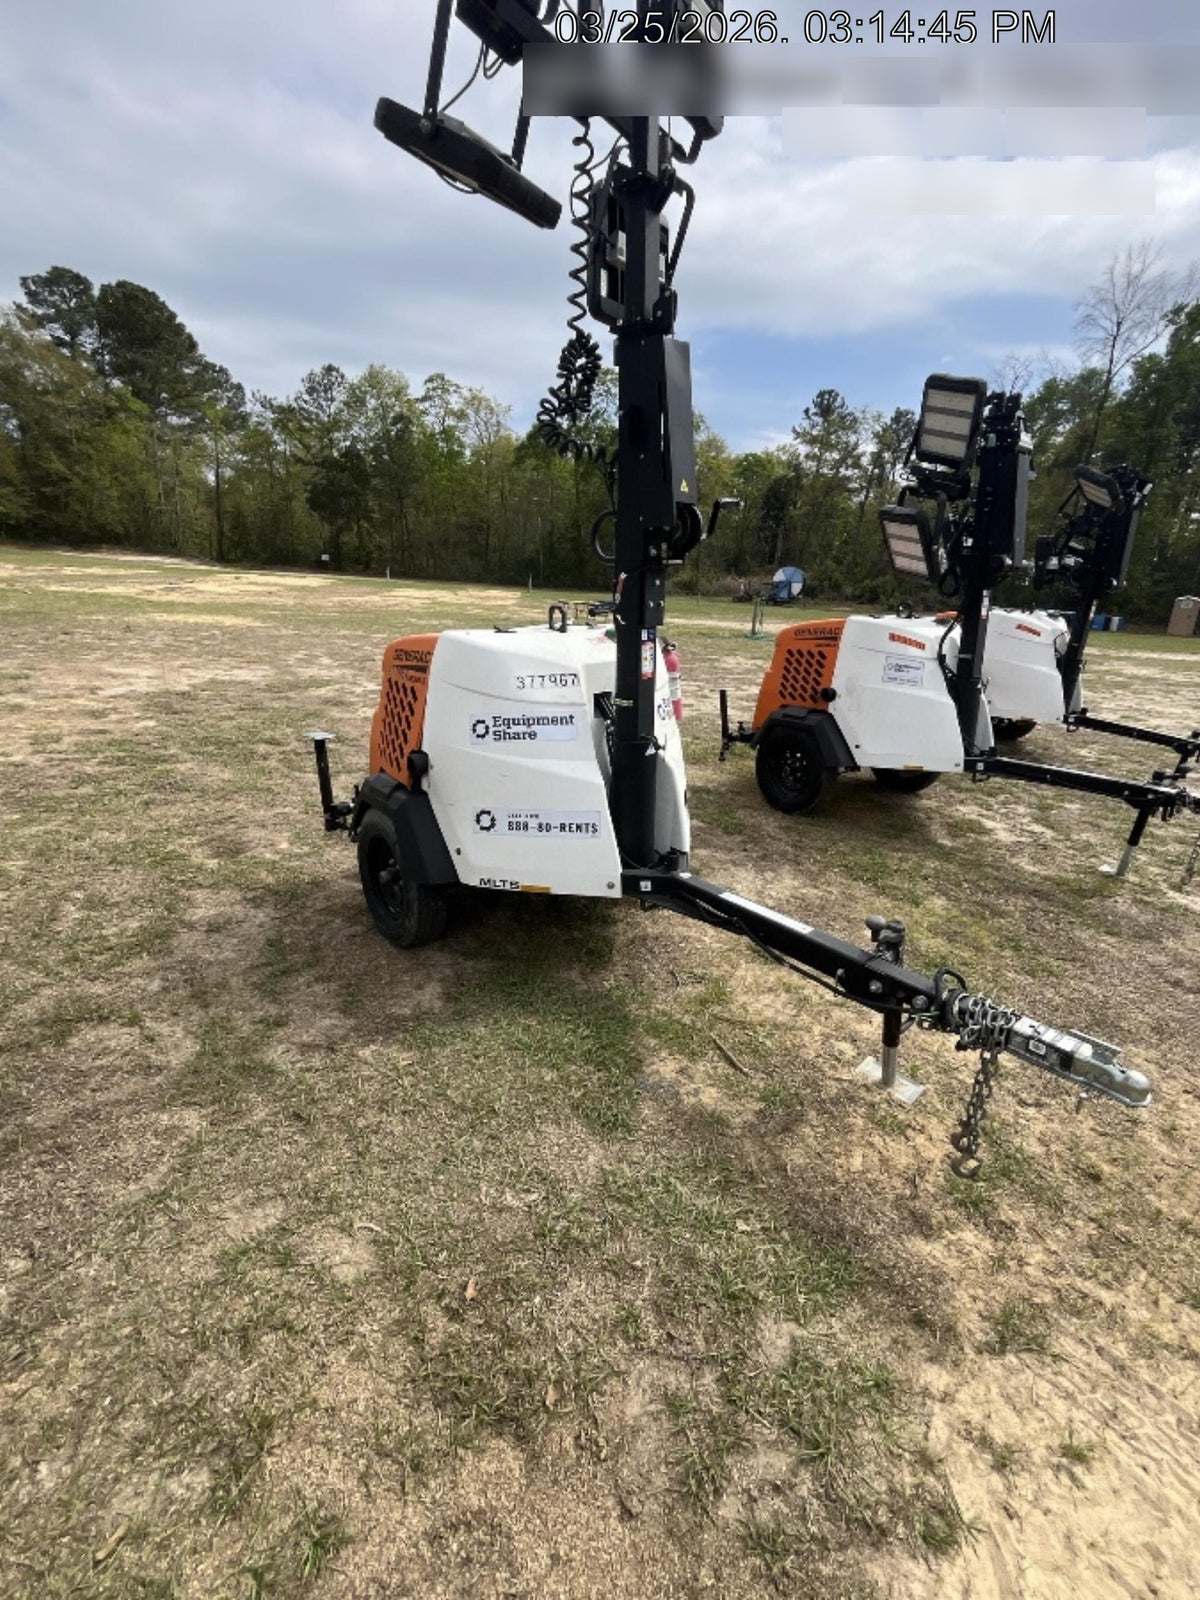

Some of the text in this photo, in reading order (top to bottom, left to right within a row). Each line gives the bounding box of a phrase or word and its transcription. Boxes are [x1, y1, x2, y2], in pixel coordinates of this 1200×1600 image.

[392, 649, 435, 663] GENERAC
[516, 673, 578, 689] 377967
[492, 713, 575, 729] Equipment
[492, 729, 538, 742] Share
